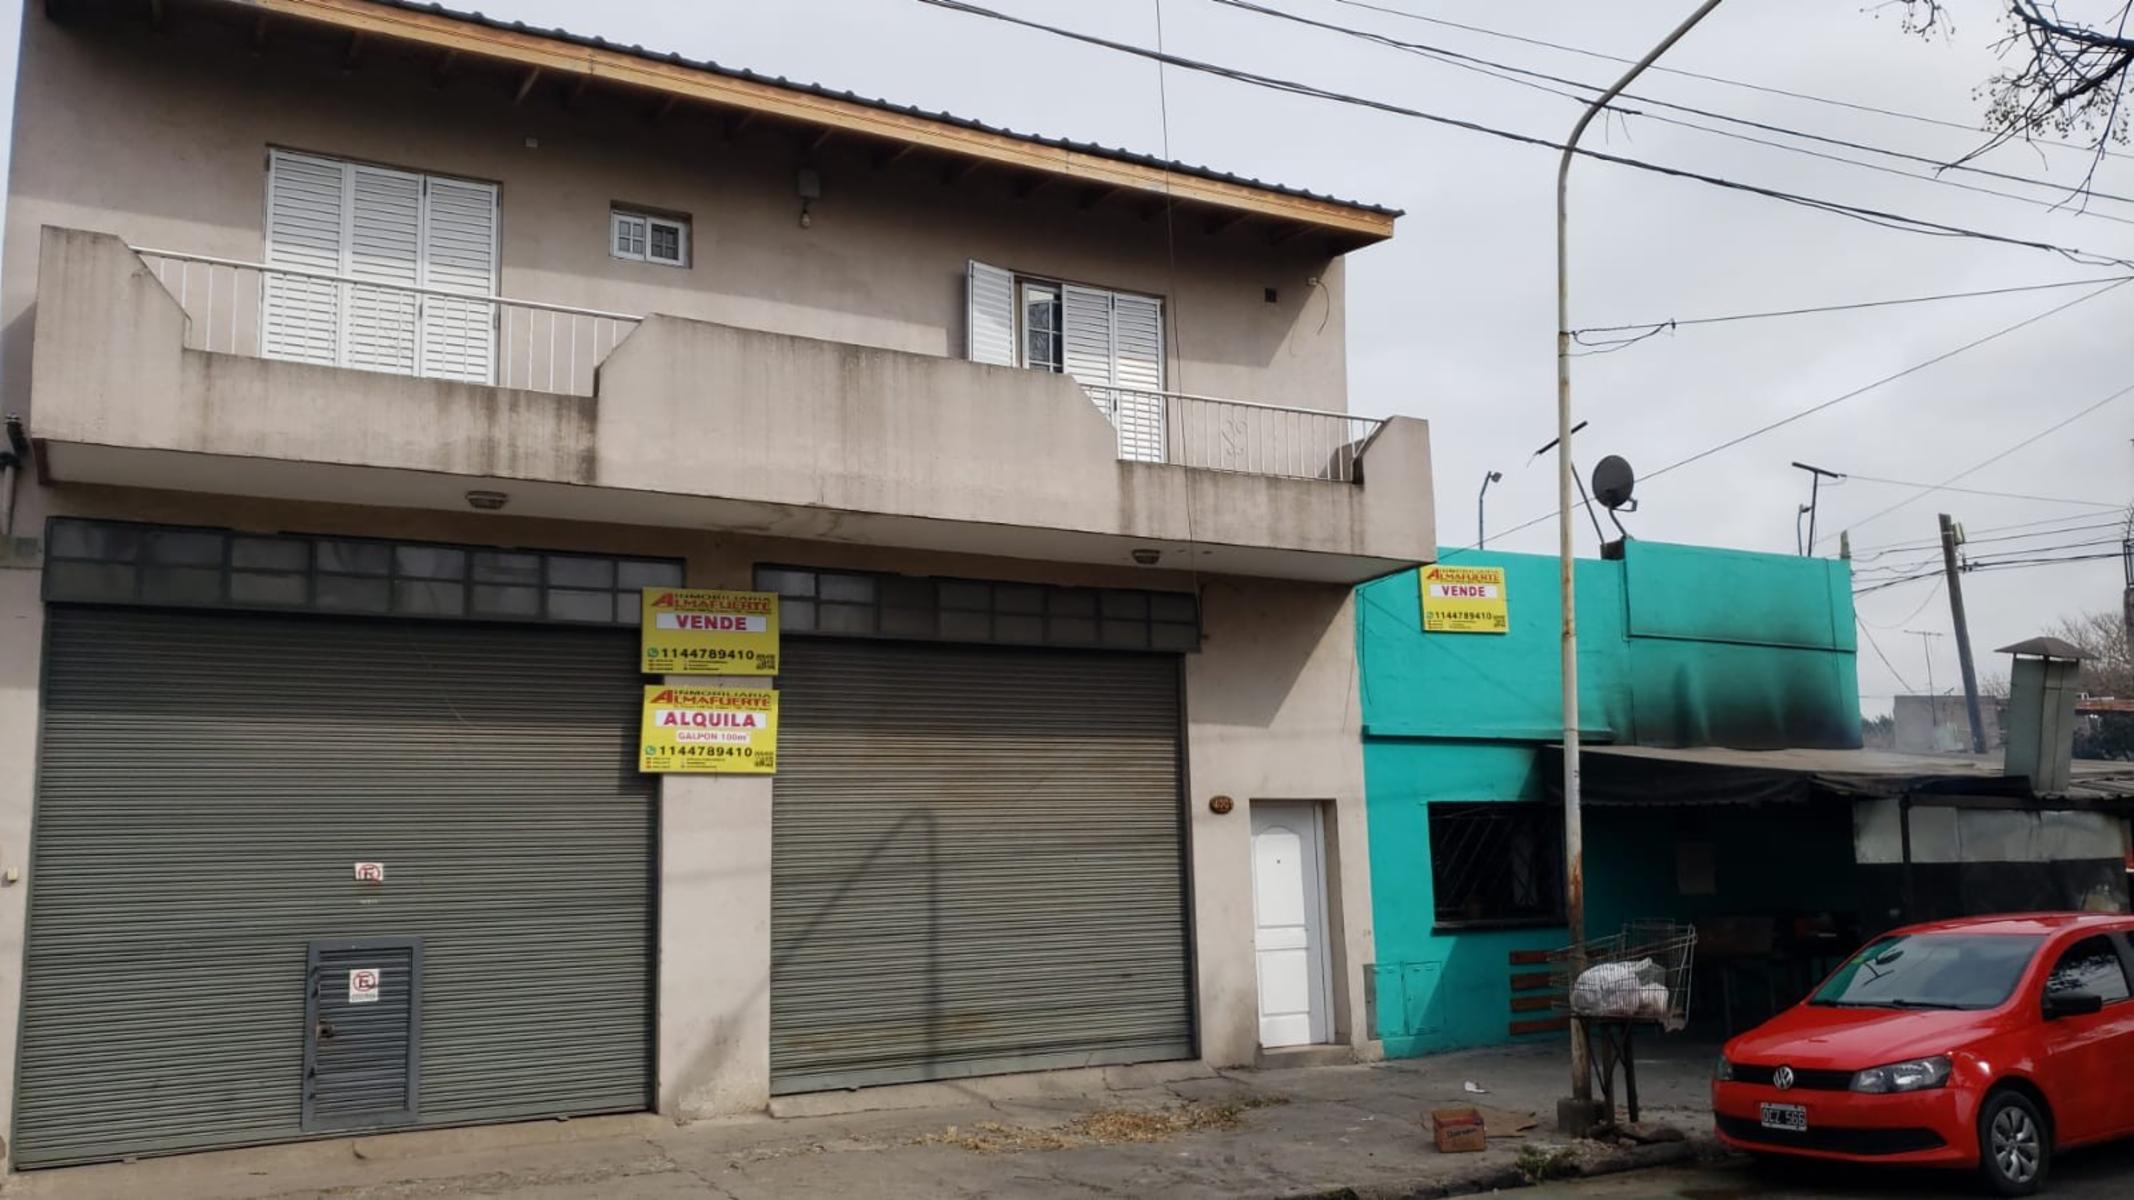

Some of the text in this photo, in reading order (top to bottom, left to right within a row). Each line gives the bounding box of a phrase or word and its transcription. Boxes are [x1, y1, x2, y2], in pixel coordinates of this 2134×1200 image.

[1427, 568, 1500, 582] ALMAFUERTE
[1442, 585, 1486, 597] VENDE
[651, 592, 771, 611] ALMAFUERTE
[1435, 611, 1492, 620] 1144789410
[676, 615, 748, 631] VENDE
[662, 648, 755, 660] 1144789410
[650, 689, 771, 707] ALMAFUERTE
[663, 711, 756, 728] ALQUILA
[678, 732, 718, 741] GALPON
[659, 746, 753, 757] 1144789410
